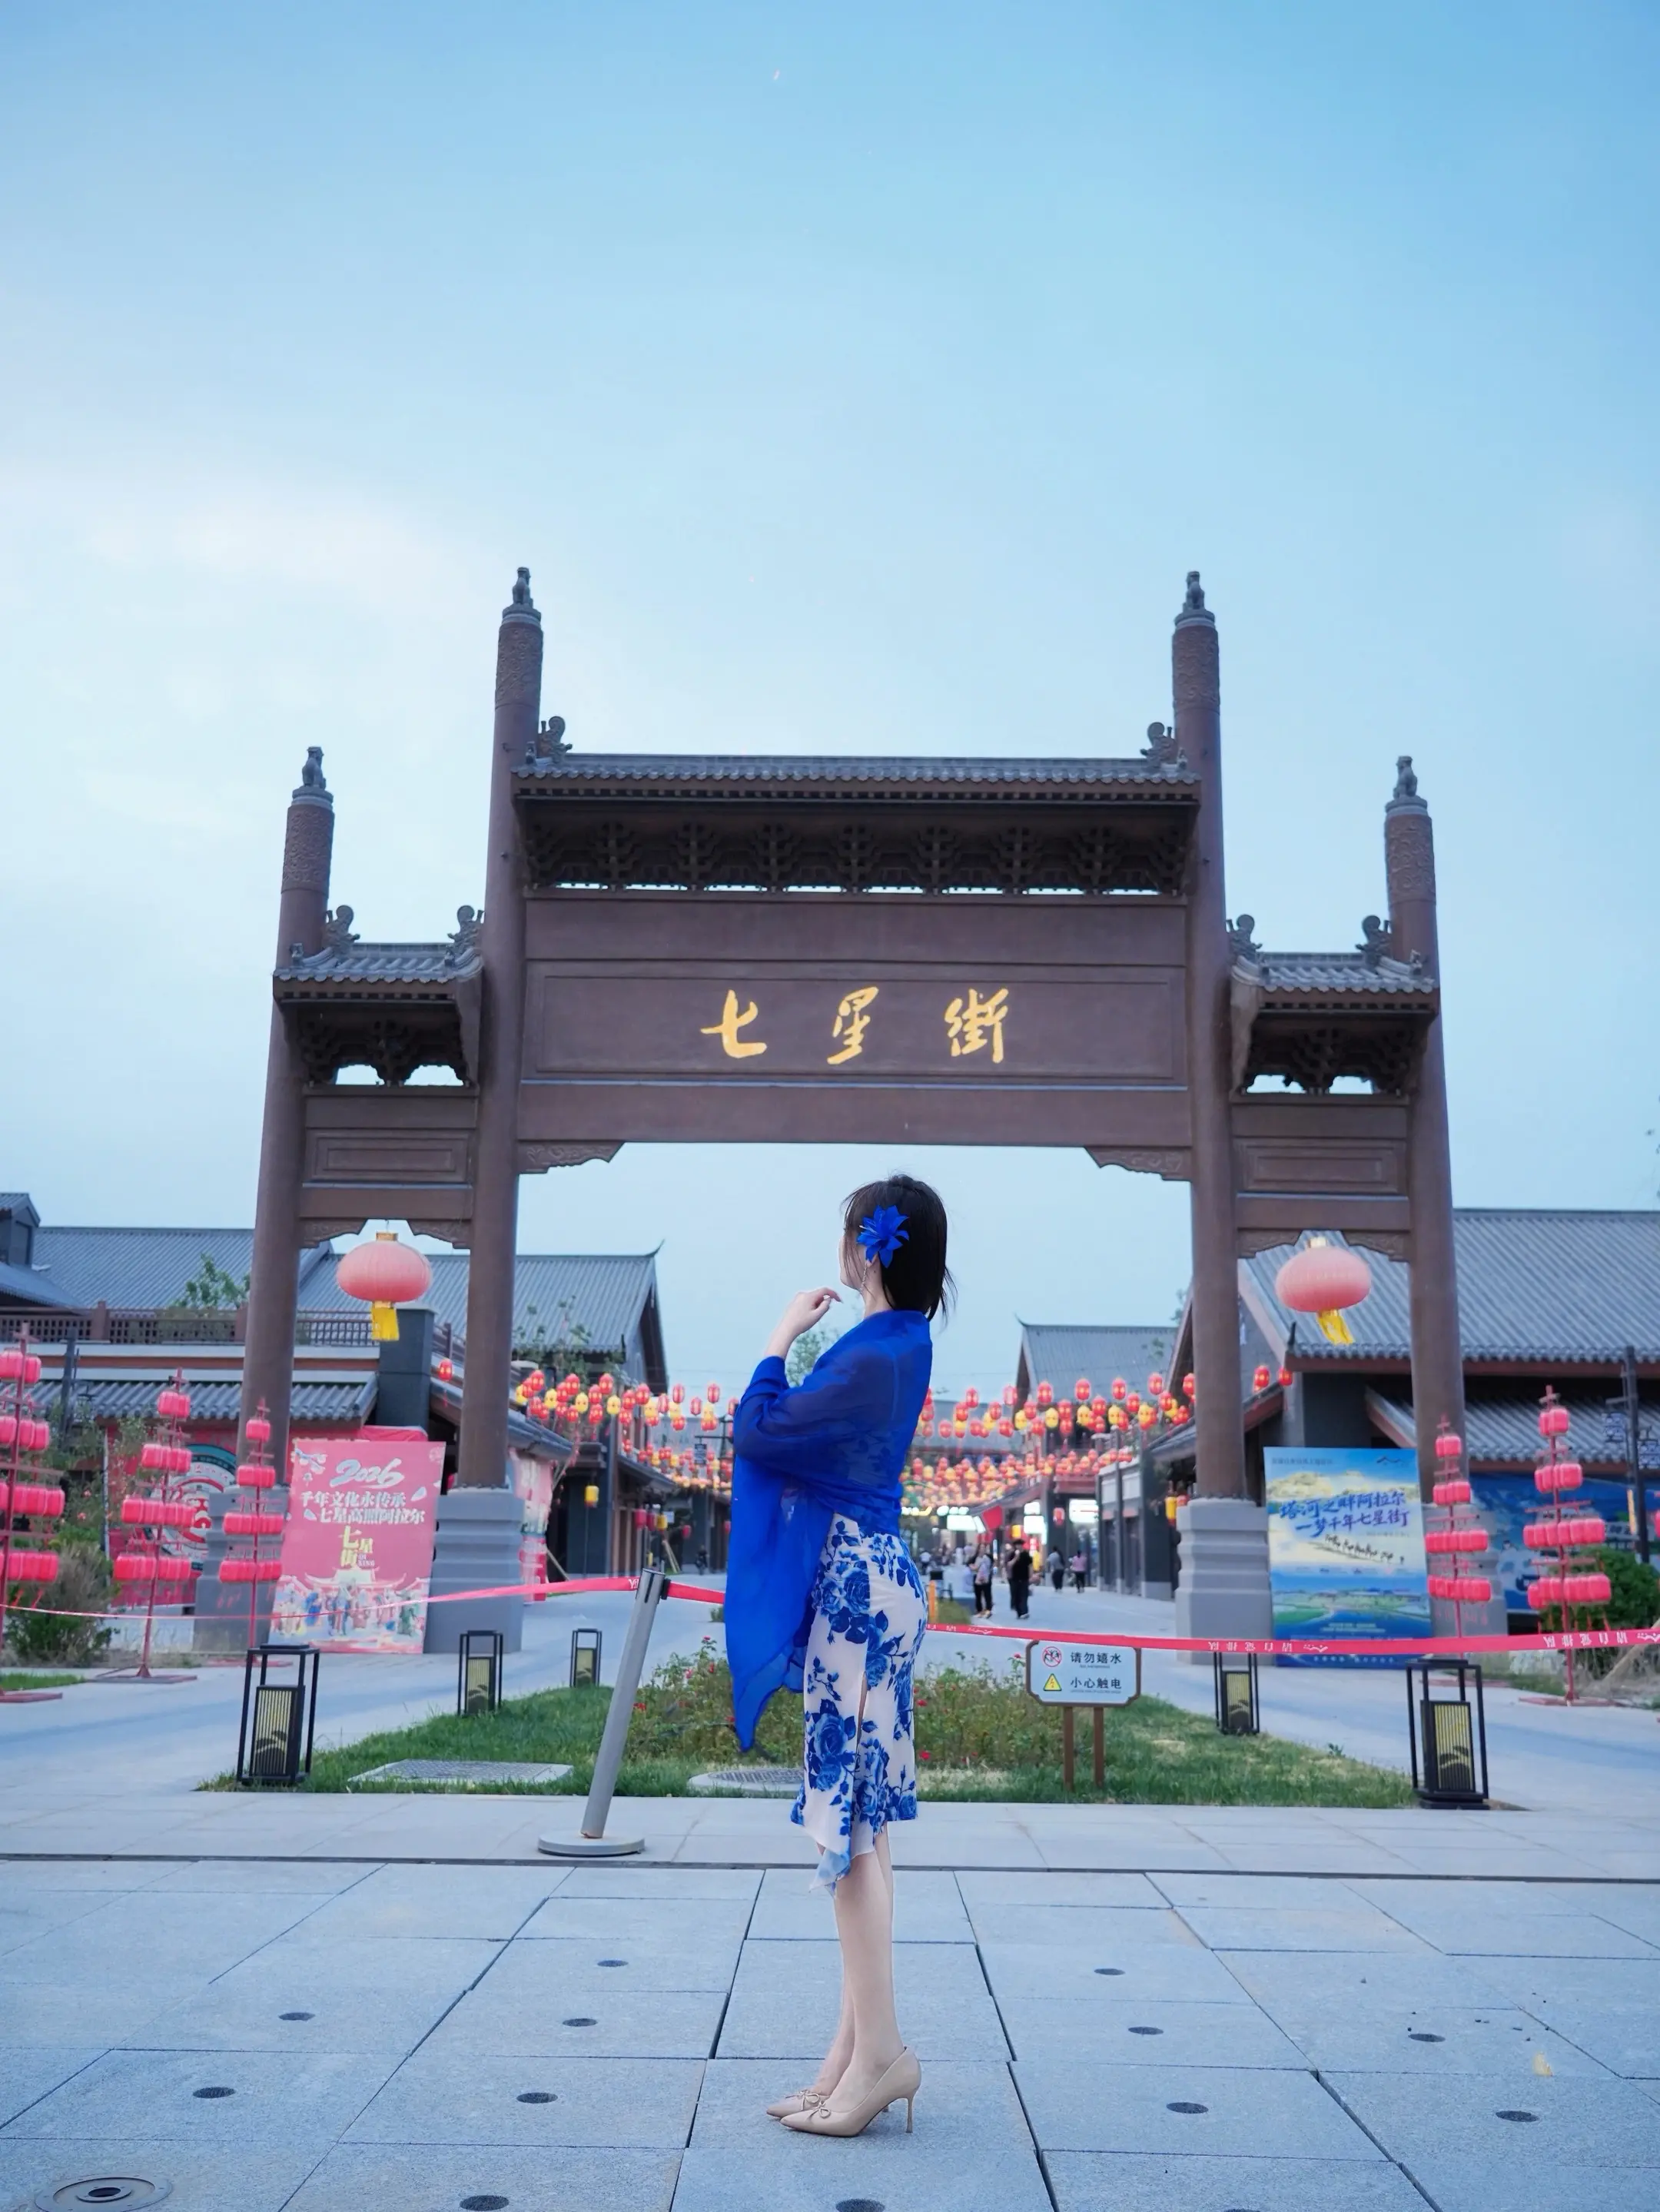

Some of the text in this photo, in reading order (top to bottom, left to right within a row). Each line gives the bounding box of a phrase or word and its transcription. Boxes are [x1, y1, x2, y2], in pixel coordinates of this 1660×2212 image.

[701, 987, 1009, 1065] 七星街
[329, 1458, 405, 1490] 2026
[300, 1491, 407, 1507] 千年文化永传承
[1279, 1490, 1406, 1520] 塔河之畔阿拉尔
[1295, 1507, 1410, 1538] 一梦千年七星街
[1071, 1652, 1122, 1664] 请勿嬉水
[1207, 1641, 1293, 1652] 请自觉排队
[1071, 1677, 1122, 1689] 小心触电
